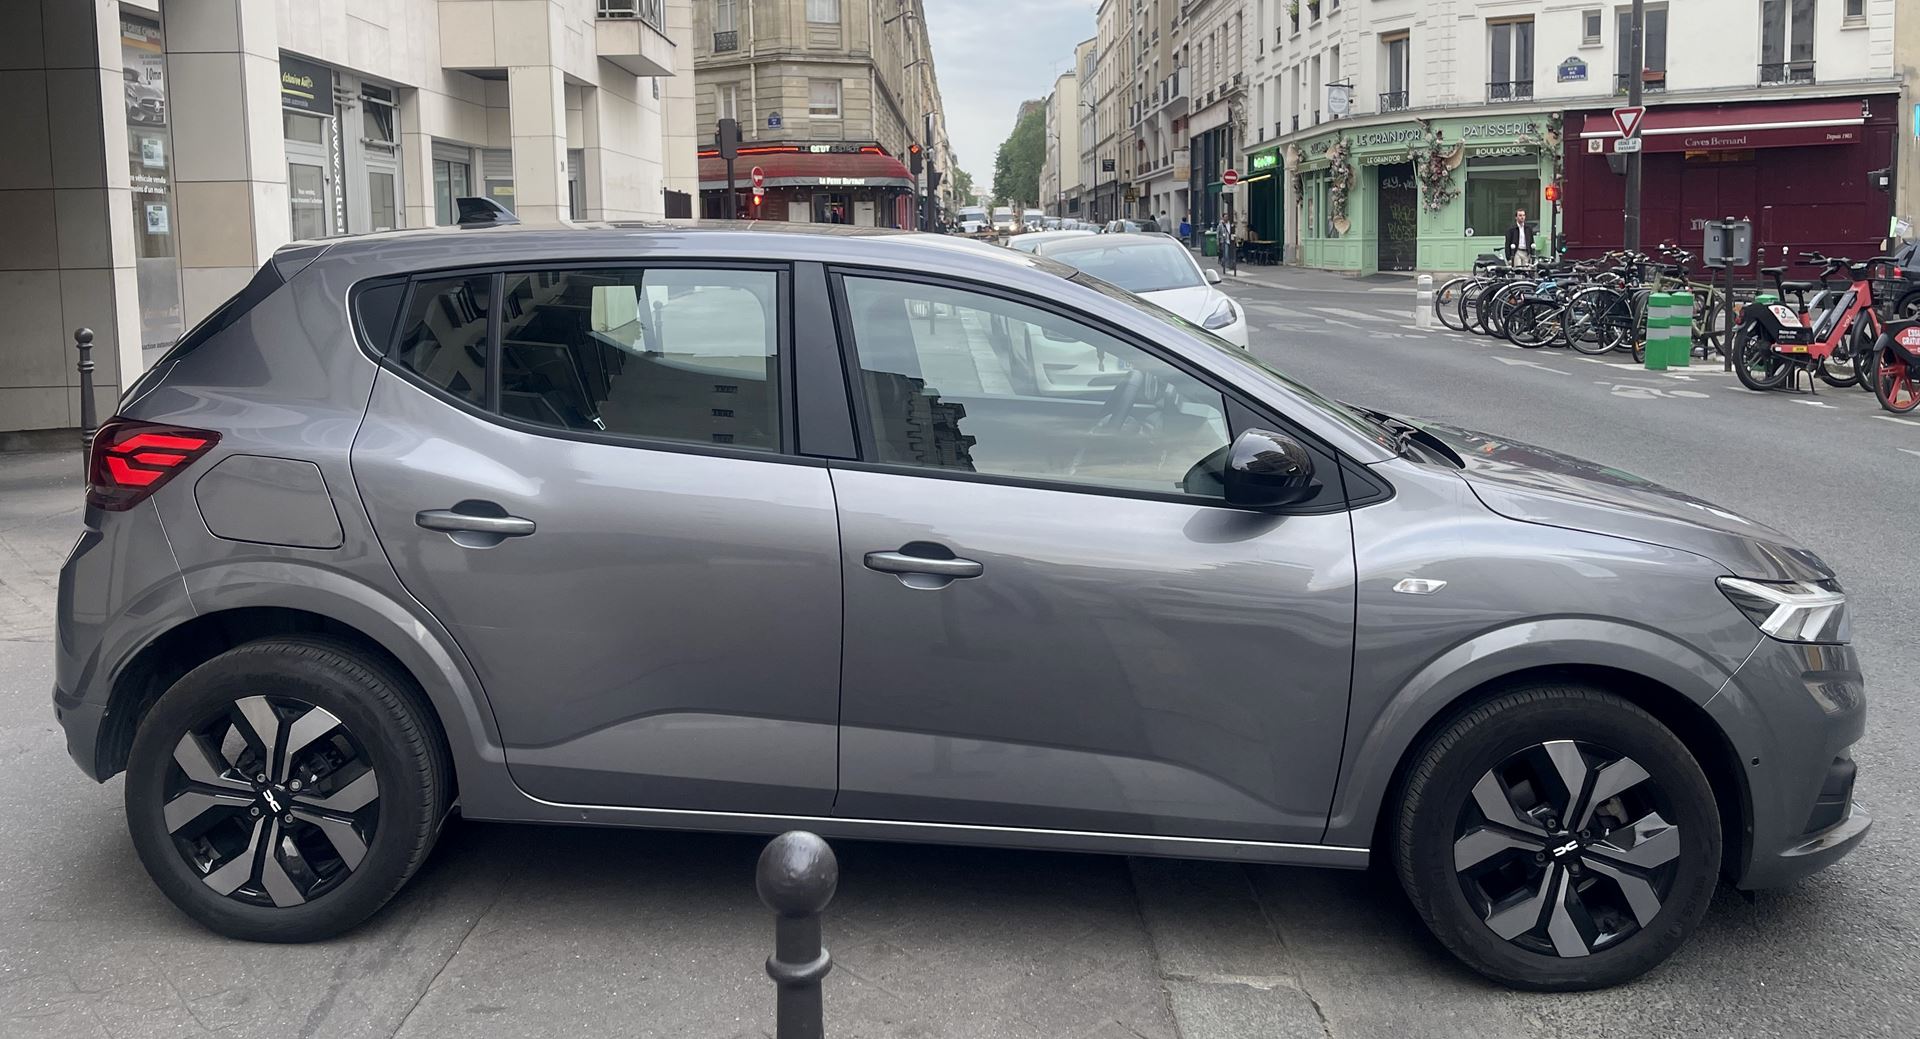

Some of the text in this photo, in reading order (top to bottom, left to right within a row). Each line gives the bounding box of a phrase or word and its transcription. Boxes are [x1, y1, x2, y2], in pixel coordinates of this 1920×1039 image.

[1463, 122, 1535, 137] PATISSERIE
[1356, 135, 1367, 146] LE
[1685, 136, 1747, 147] Caves Bernard
[1476, 146, 1526, 156] BOULANGERIE
